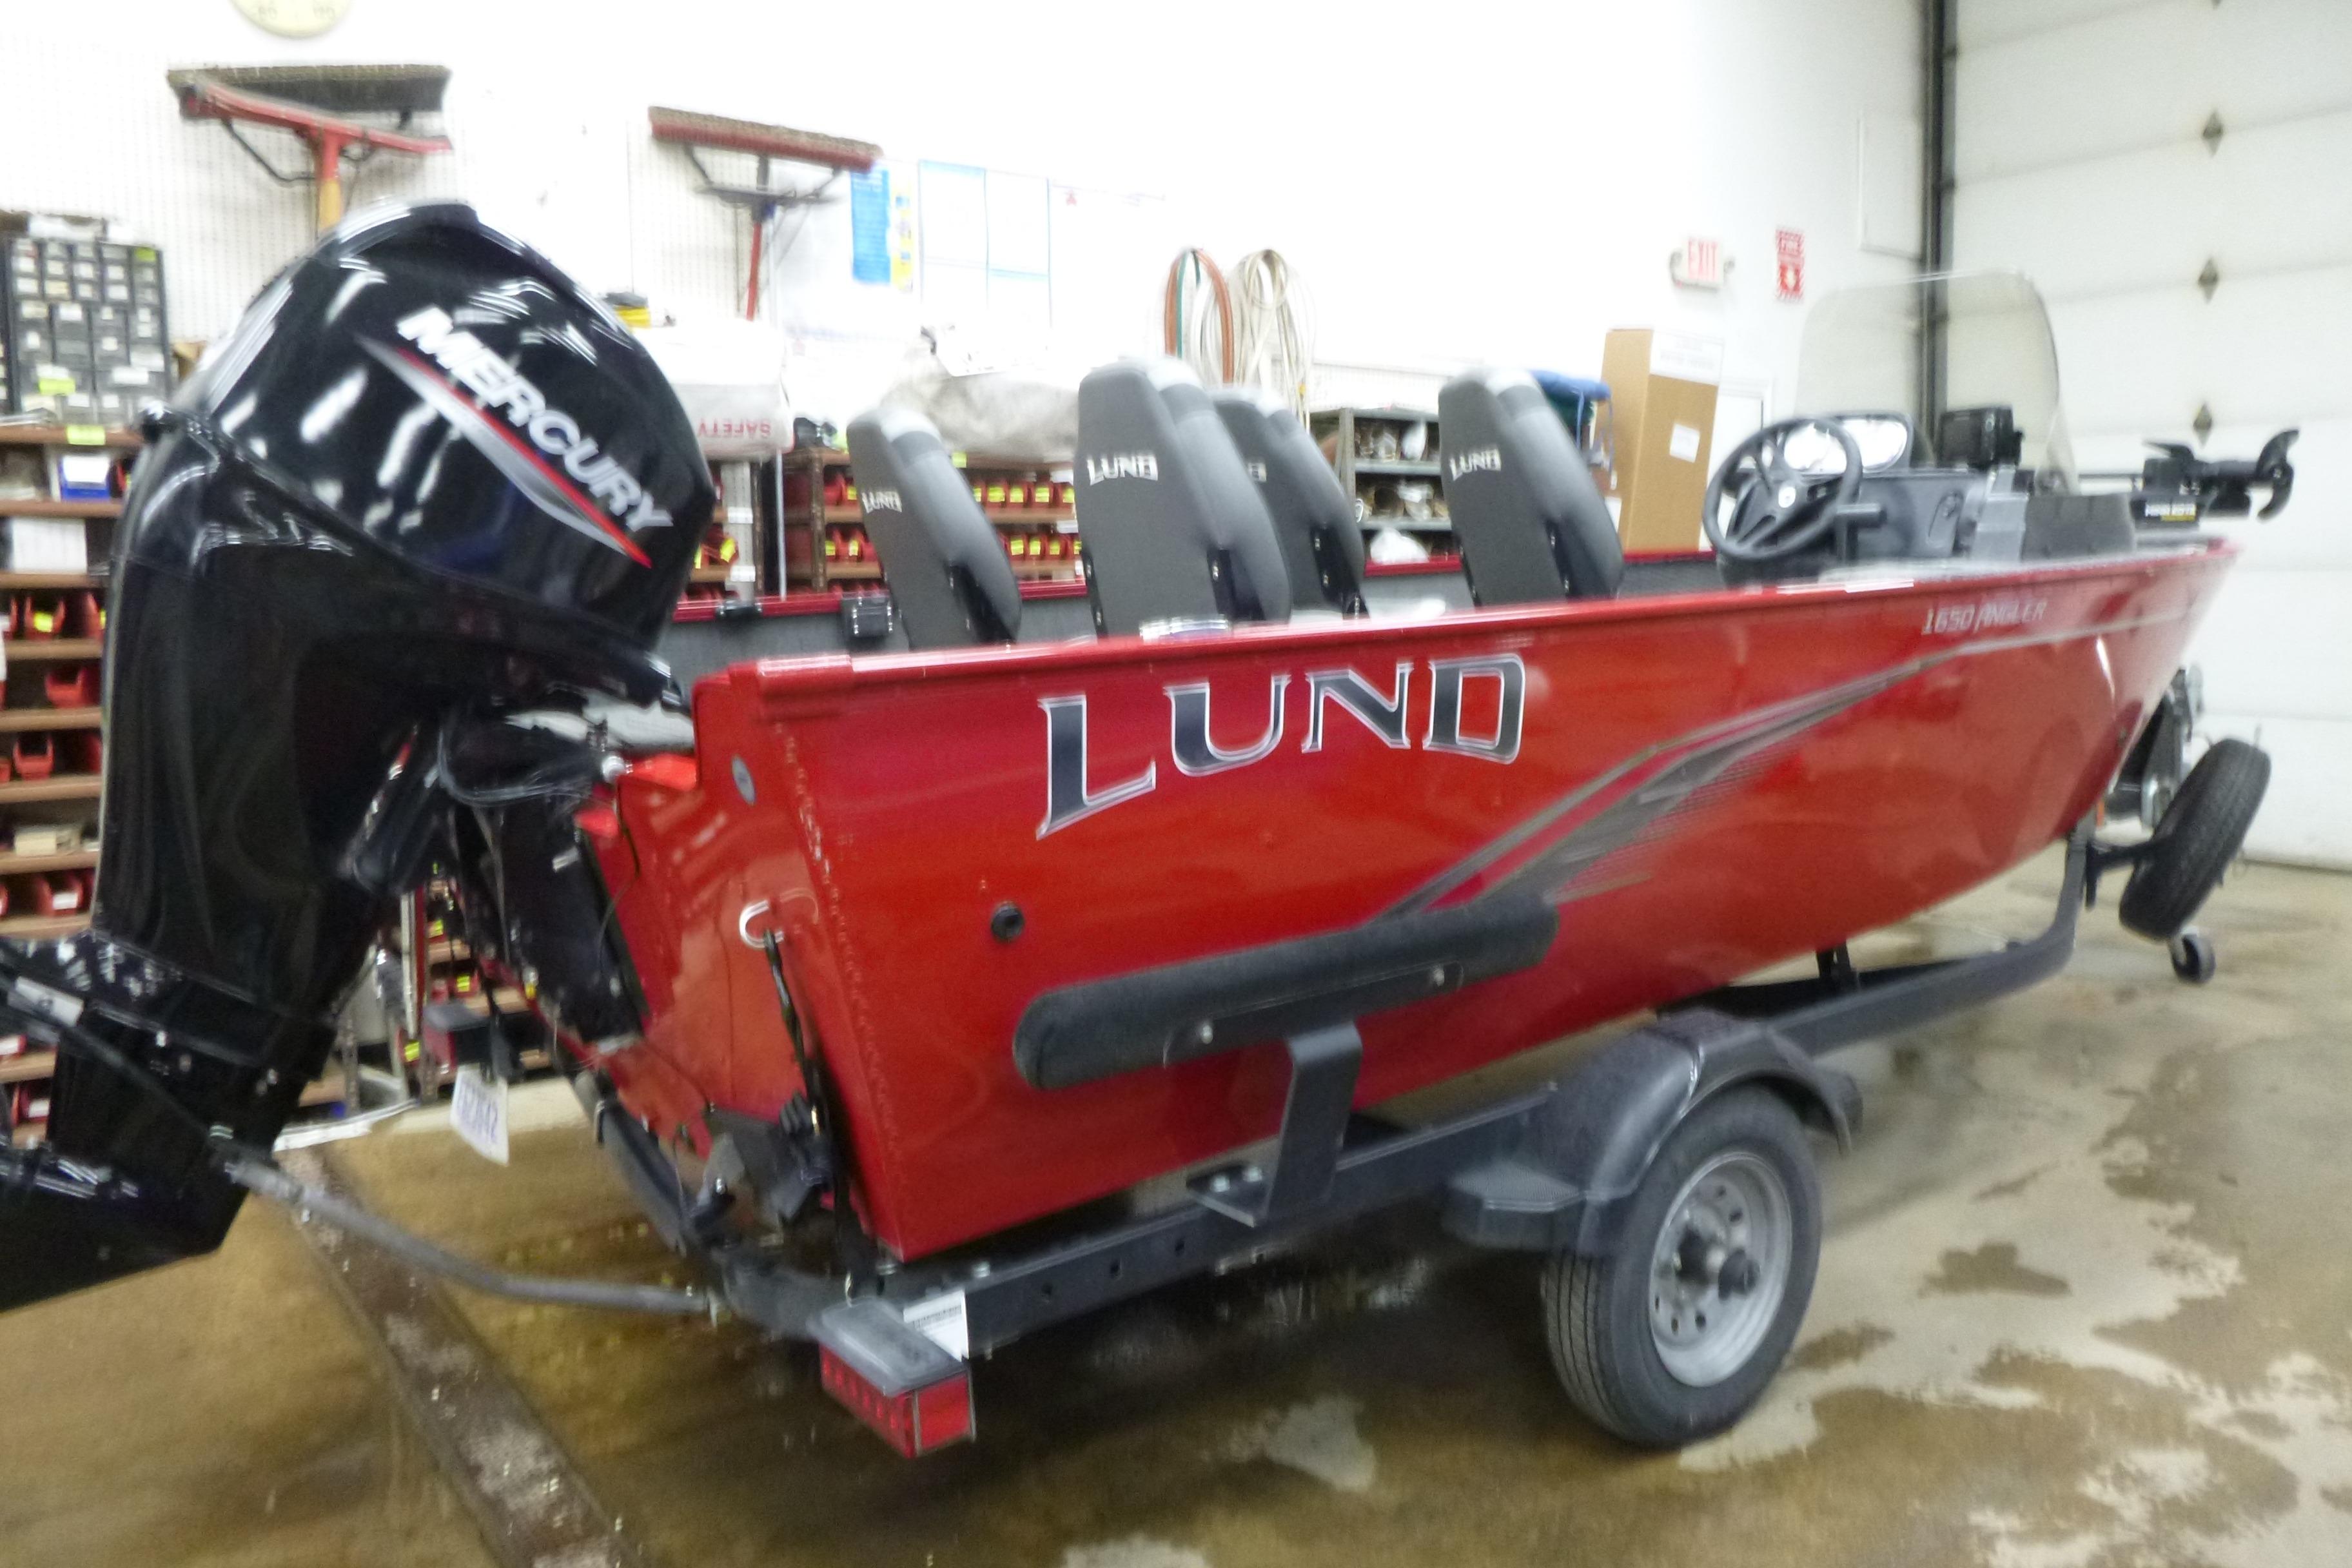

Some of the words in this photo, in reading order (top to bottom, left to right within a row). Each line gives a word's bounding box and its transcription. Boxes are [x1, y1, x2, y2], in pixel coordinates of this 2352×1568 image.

[1687, 237, 1718, 280] EXIT
[397, 305, 674, 533] MERCURY
[698, 422, 771, 440] SAFETY
[1087, 453, 1158, 485] LUND
[1449, 449, 1502, 481] LUND
[1921, 604, 1975, 635] 1650
[1974, 598, 2048, 633] ANGLER
[1036, 653, 1526, 839] LUND
